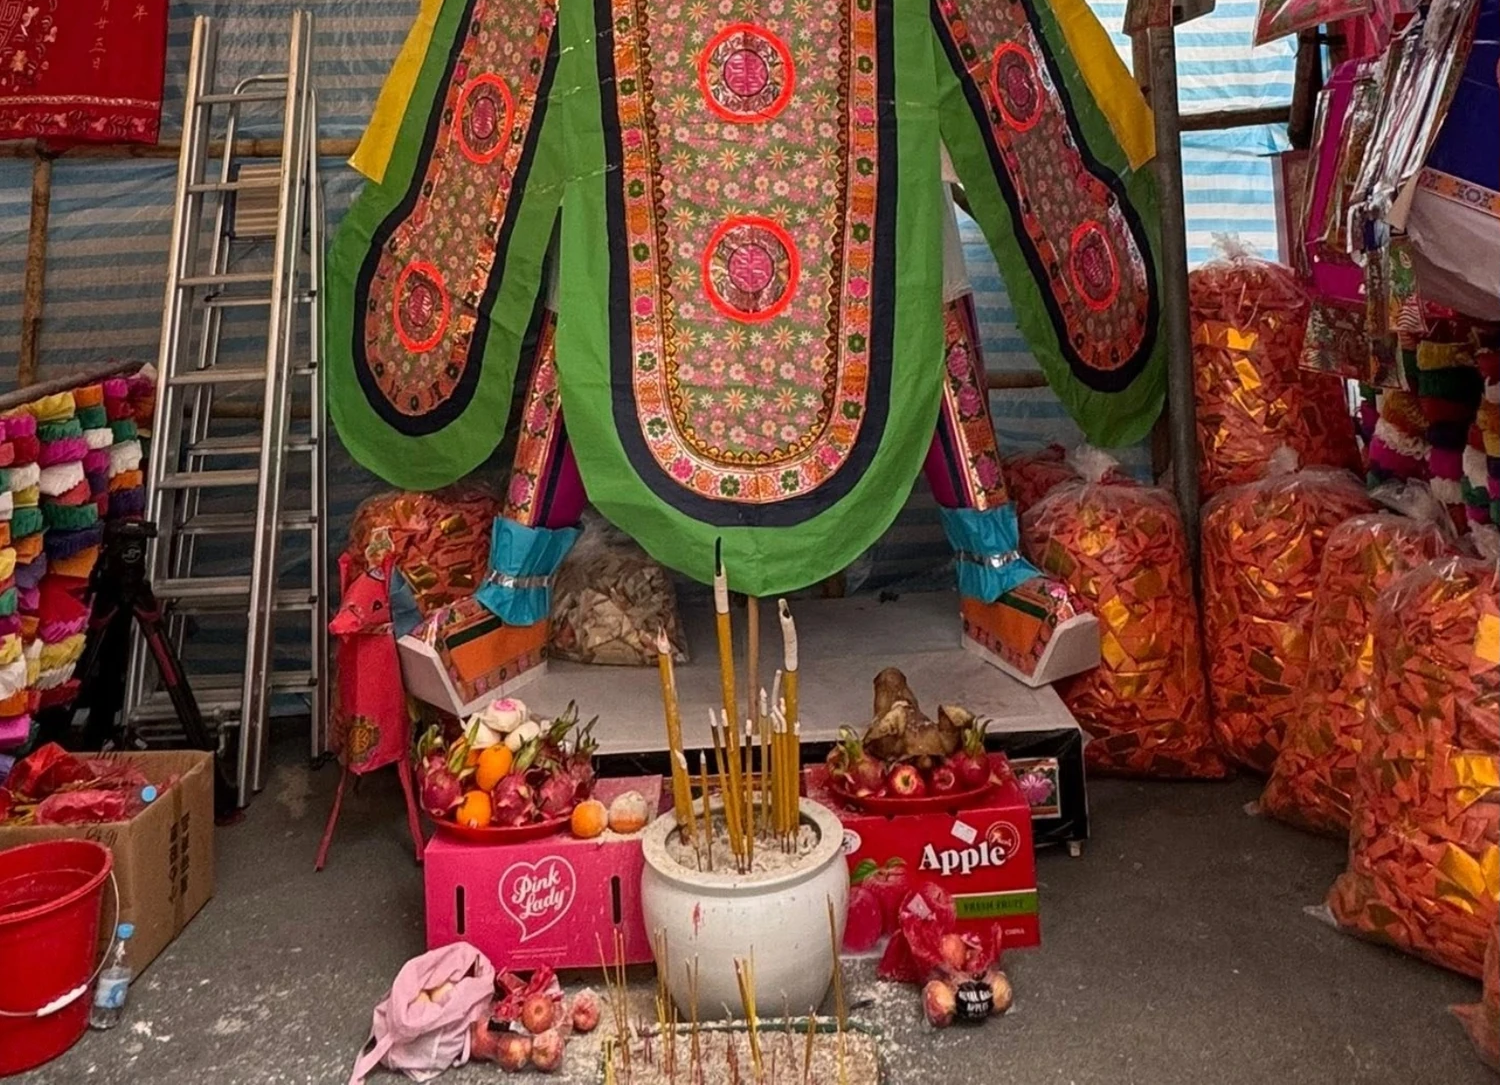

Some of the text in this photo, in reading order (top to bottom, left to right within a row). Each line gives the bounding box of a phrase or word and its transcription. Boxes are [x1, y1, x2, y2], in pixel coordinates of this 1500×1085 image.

[918, 840, 1007, 876] Apple
[511, 860, 561, 904] Pink
[519, 886, 566, 920] Lady
